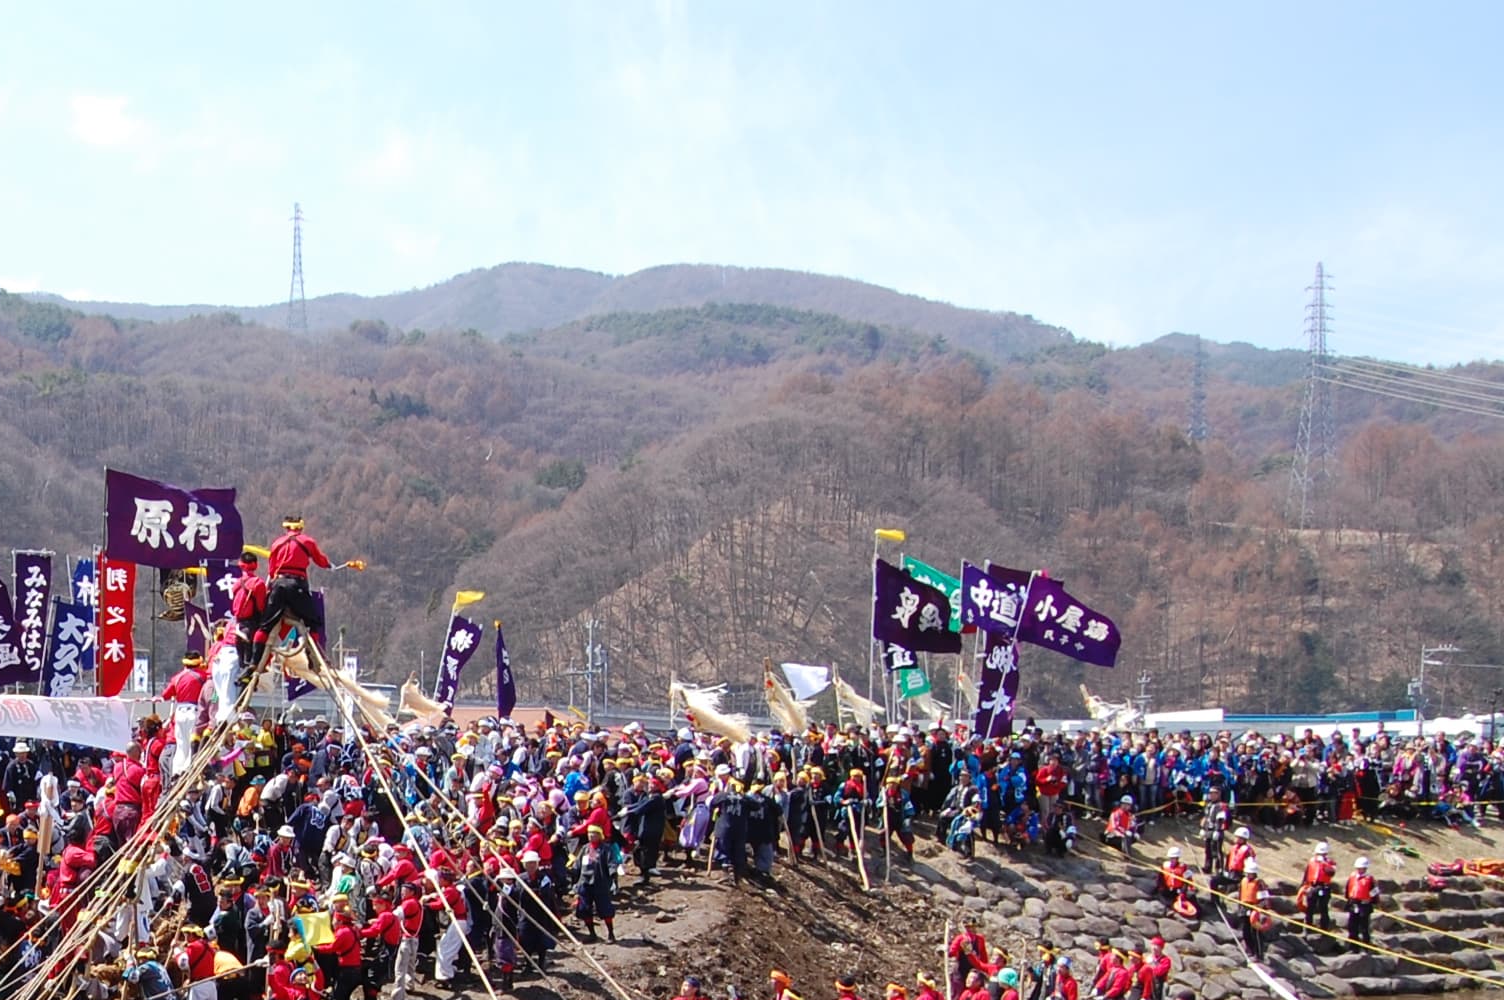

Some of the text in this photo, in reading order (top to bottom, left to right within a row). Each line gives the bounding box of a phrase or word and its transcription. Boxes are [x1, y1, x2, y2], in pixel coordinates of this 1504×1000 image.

[130, 497, 223, 551] 原村
[21, 566, 47, 671] みなみはら
[970, 579, 1017, 627] 中道
[1034, 594, 1110, 641] 小屋場
